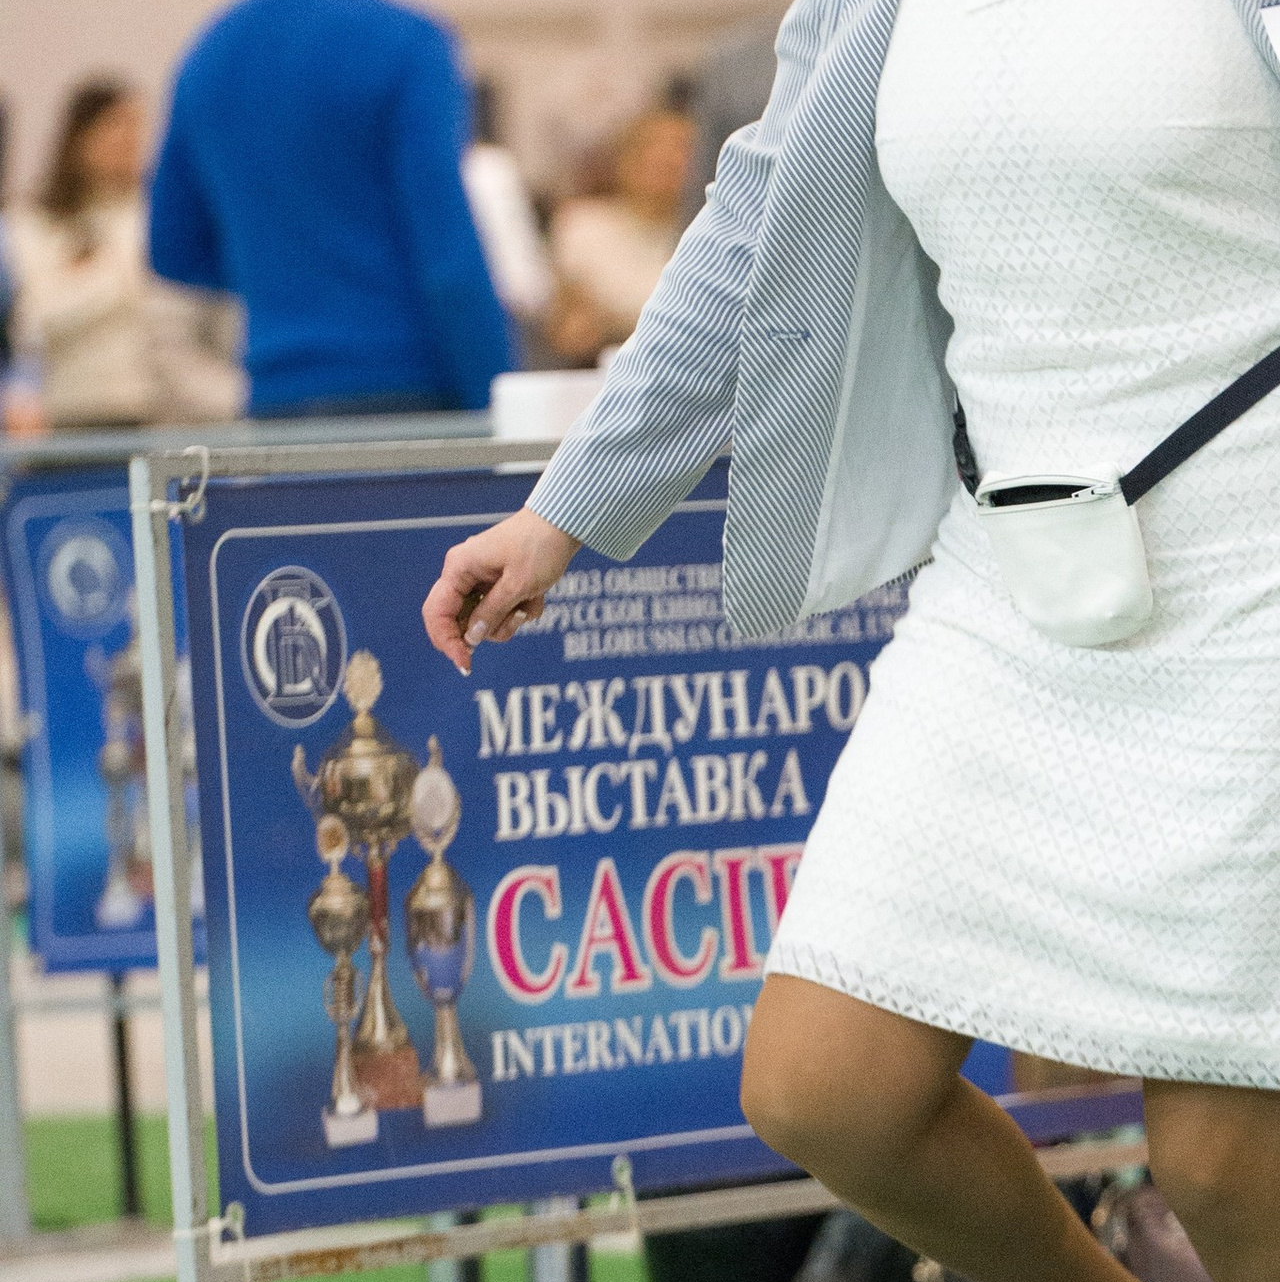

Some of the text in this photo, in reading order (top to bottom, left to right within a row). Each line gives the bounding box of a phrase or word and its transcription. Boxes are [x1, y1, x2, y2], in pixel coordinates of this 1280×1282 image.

[474, 660, 872, 759] МЕЖДУНАРО
[495, 747, 811, 842] ВЫСТАВКА
[491, 1003, 754, 1083] INTERNATIO
